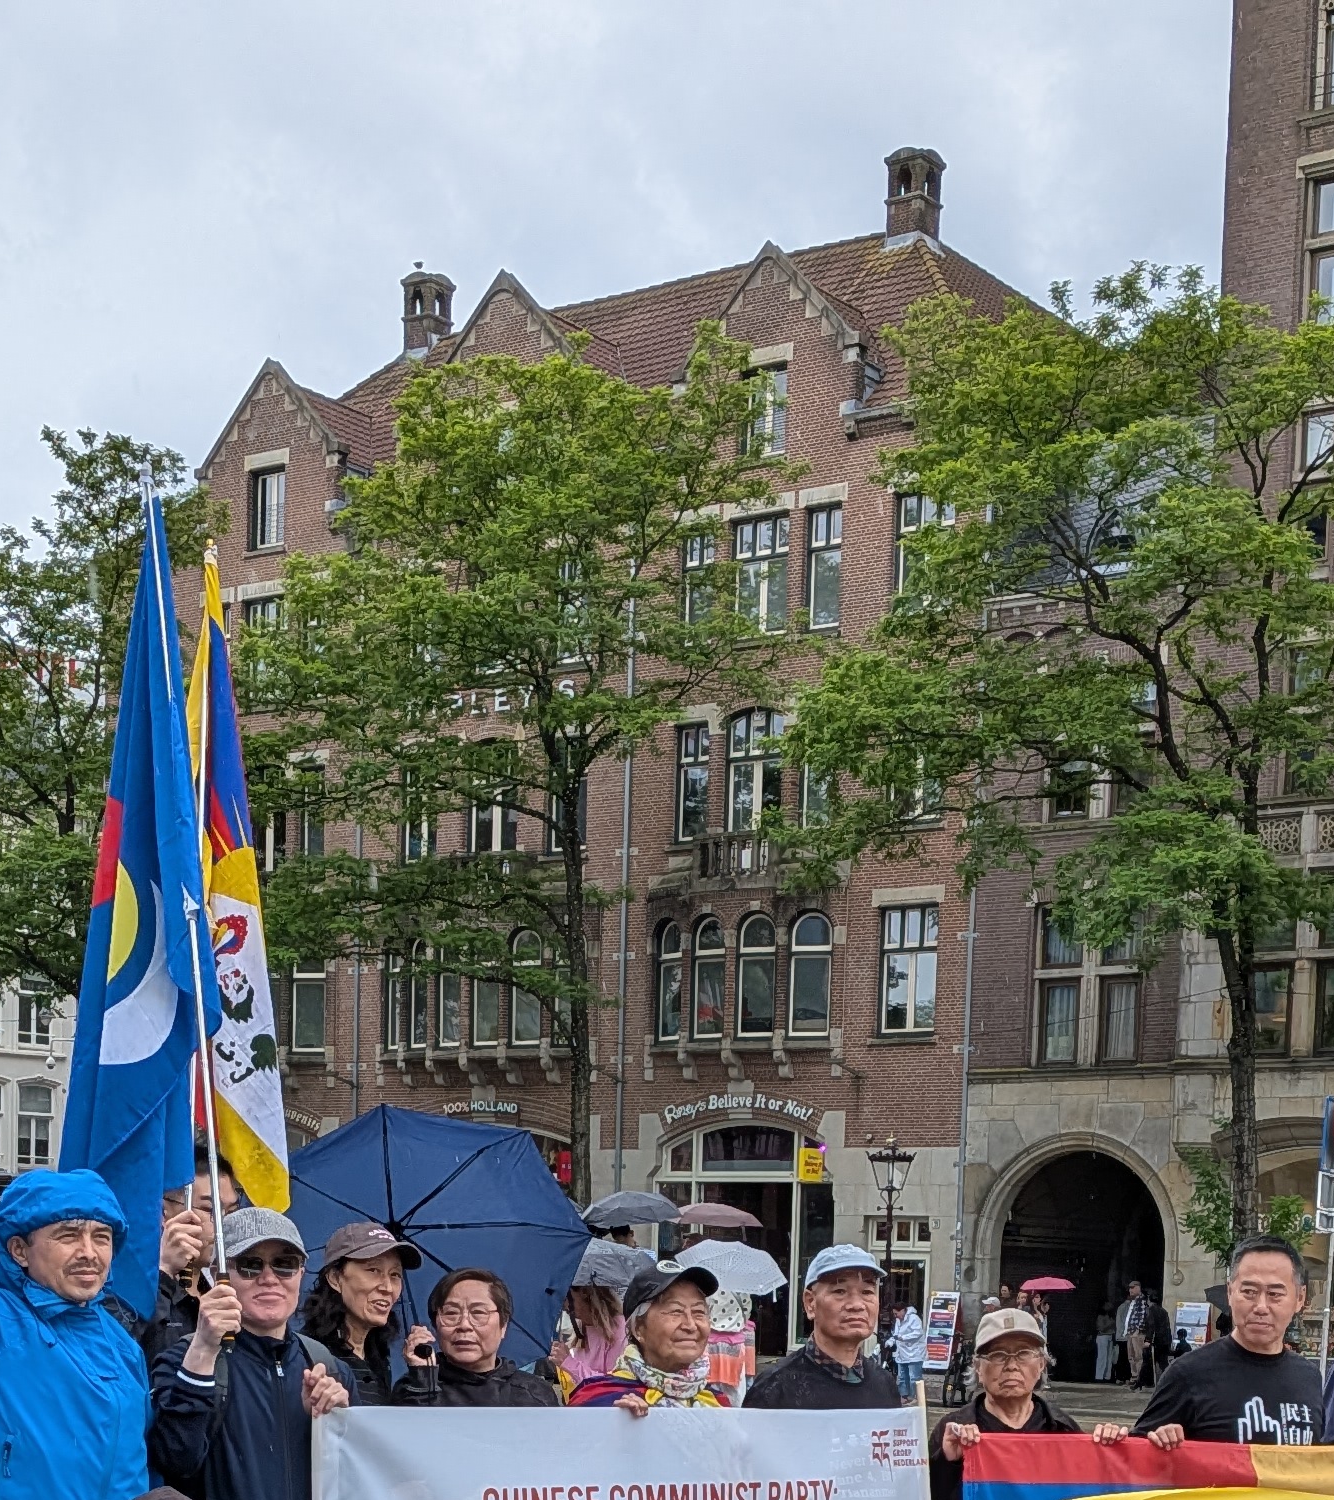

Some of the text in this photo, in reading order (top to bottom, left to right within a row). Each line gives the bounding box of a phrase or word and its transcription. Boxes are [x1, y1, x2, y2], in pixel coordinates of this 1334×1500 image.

[442, 1100, 518, 1114] 100% HOLLAND
[707, 1093, 753, 1110] Believe
[754, 1092, 767, 1109] It
[768, 1098, 784, 1111] or
[782, 1099, 814, 1122] Not!
[893, 1458, 928, 1467] NEDERLAN
